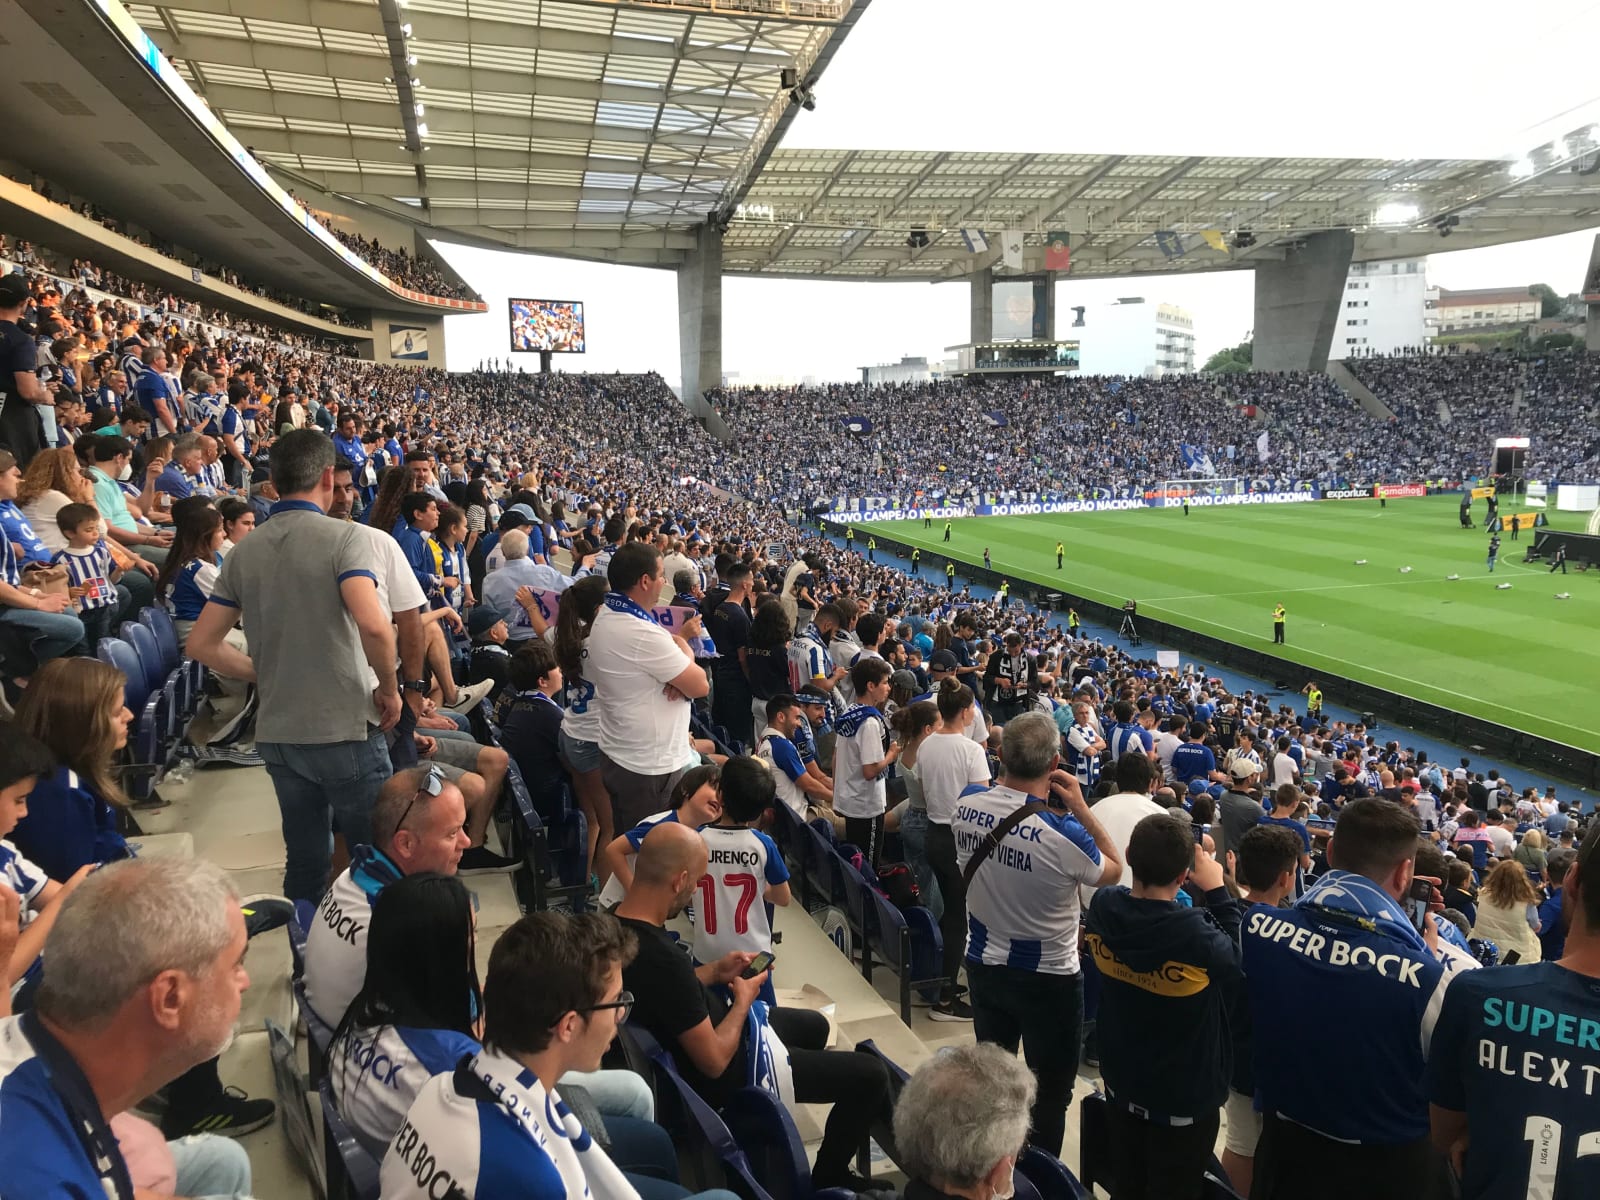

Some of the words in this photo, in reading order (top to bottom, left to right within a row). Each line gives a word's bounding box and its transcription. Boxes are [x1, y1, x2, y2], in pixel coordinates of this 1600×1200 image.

[830, 511, 862, 523] NOVO
[919, 507, 975, 519] NACIONA
[992, 505, 1008, 515] DO
[1010, 504, 1042, 514] NOVO
[1043, 499, 1095, 513] CAMPEÃO
[1166, 496, 1182, 507] DO
[1185, 496, 1213, 506] OVO
[1214, 492, 1262, 505] CAMPEÃO
[1264, 492, 1315, 503] NACIONAL
[957, 805, 995, 829] SUPER
[957, 830, 995, 859] ANTÓO
[997, 843, 1032, 872] VIEIRA
[323, 900, 364, 945] BOCK
[697, 872, 758, 935] 17
[1247, 912, 1326, 961] SUPER
[1329, 939, 1424, 988] BOCK
[1483, 997, 1600, 1051] SUPER
[1479, 1039, 1570, 1089] ALEX
[1540, 1148, 1548, 1164] LIGA
